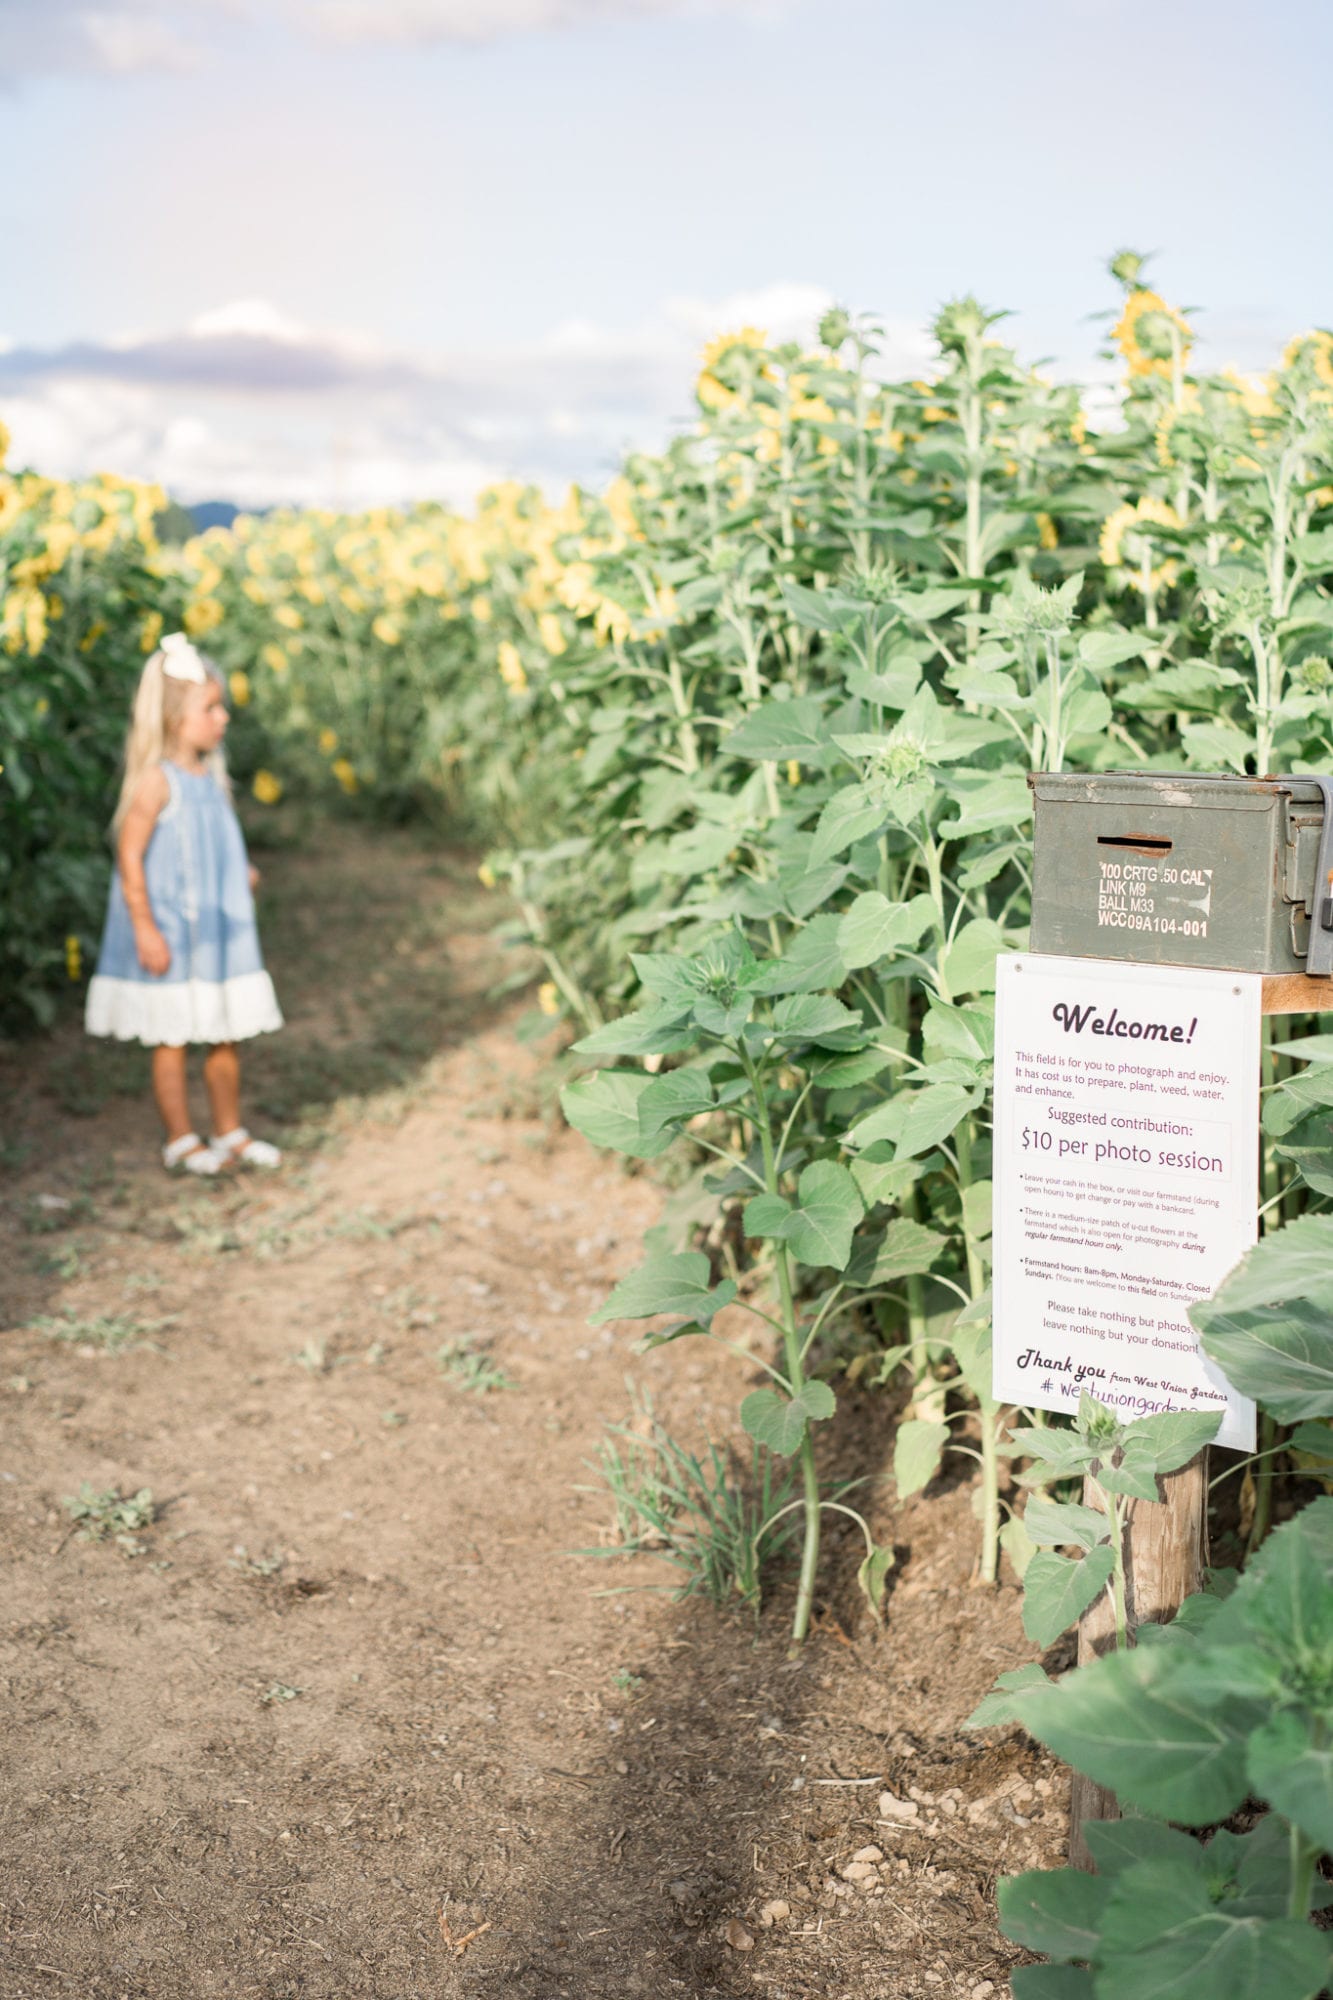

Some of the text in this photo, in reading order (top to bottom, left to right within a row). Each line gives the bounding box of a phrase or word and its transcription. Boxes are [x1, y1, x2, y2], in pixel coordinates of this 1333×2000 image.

[1099, 879, 1146, 897] LINK M9
[1100, 863, 1206, 886] 100 CRTG .50 CAL
[1098, 895, 1154, 913] BALL M33
[1098, 911, 1207, 937] WCC09A104-001
[1052, 1002, 1198, 1044] Welcome!
[1015, 1051, 1230, 1086] This field is for you to photograph and enjoy.
[1015, 1066, 1022, 1077] It
[1024, 1067, 1040, 1079] has
[1041, 1071, 1060, 1082] cost
[1062, 1074, 1073, 1083] us
[1074, 1074, 1085, 1085] to
[1015, 1083, 1075, 1100] and enhance.
[1047, 1106, 1193, 1137] Suggested contribution:
[1021, 1126, 1223, 1173] $10 per photo session
[1024, 1173, 1044, 1183] Leave
[1045, 1177, 1061, 1185] your
[1062, 1179, 1077, 1187] cash
[1078, 1181, 1085, 1189] in
[1087, 1181, 1098, 1190] the
[1126, 1188, 1141, 1196] visit
[1142, 1190, 1155, 1198] our
[1156, 1190, 1192, 1203] farmstand
[1193, 1196, 1220, 1209] (during
[1024, 1186, 1042, 1194] open
[1066, 1191, 1074, 1199] to
[1075, 1192, 1086, 1201] get
[1087, 1193, 1112, 1205] change
[1122, 1199, 1137, 1208] pay
[1137, 1201, 1154, 1209] with
[1024, 1218, 1206, 1254] farmstand which is also open for photography during
[1025, 1207, 1044, 1217] There
[1045, 1210, 1050, 1218] is
[1058, 1213, 1099, 1225] medium-size
[1101, 1219, 1120, 1228] patch
[1122, 1221, 1131, 1229] of
[1132, 1223, 1149, 1232] u-cut
[1150, 1225, 1176, 1236] flowers
[1186, 1231, 1199, 1240] the
[1024, 1230, 1049, 1240] regular
[1049, 1232, 1084, 1245] farmstand
[1084, 1238, 1104, 1249] hours
[1024, 1257, 1060, 1270] Farmstand
[1186, 1282, 1211, 1293] Closed
[1086, 1279, 1117, 1290] welcome
[1128, 1285, 1140, 1294] this
[1141, 1286, 1157, 1296] field
[1158, 1290, 1168, 1298] on
[1047, 1299, 1076, 1315] Please
[1077, 1306, 1098, 1319] take
[1099, 1311, 1137, 1328] nothing
[1138, 1315, 1155, 1328] but
[1043, 1317, 1199, 1354] leave nothing but your donation!
[1017, 1348, 1228, 1401] Thank you from West Union Gardens
